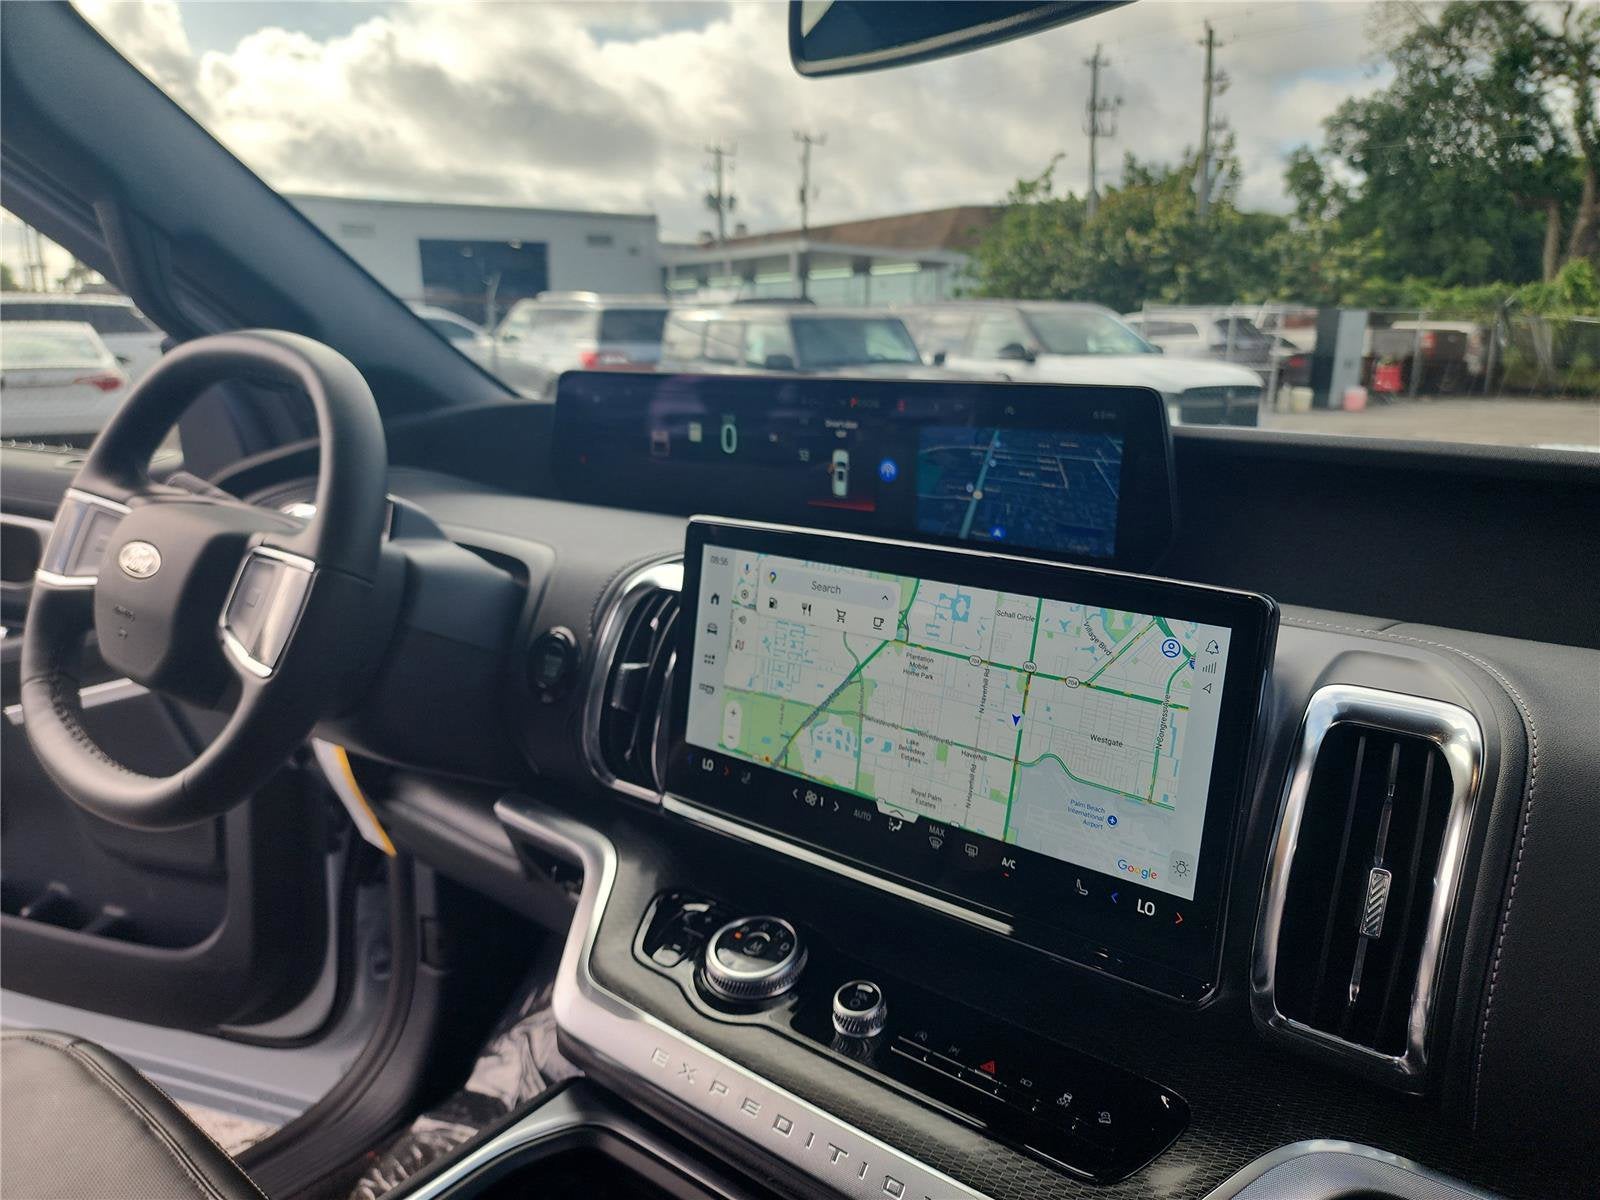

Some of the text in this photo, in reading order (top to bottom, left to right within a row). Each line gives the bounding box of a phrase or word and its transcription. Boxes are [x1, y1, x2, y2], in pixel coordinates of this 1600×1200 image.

[721, 423, 737, 453] 0
[811, 580, 842, 596] Search
[995, 609, 1036, 623] Schall Circle
[1083, 620, 1112, 656] Village Blvd
[906, 652, 934, 664] Plantation
[909, 661, 928, 671] Mobile
[983, 668, 990, 678] Rd
[903, 668, 934, 681] Home Park
[1067, 679, 1078, 687] 704
[1157, 708, 1168, 742] Congress
[905, 738, 919, 747] Lake
[1090, 733, 1124, 748] Westgate
[911, 787, 943, 802] Royal Palm
[915, 798, 936, 809] Estates
[1070, 799, 1105, 813] Palm Beach
[853, 808, 872, 822] AUTO
[1067, 806, 1105, 822] International
[928, 824, 945, 838] MAX
[1082, 819, 1103, 830] Airport
[1001, 856, 1016, 870] A/C
[1117, 859, 1158, 880] Google
[1137, 898, 1156, 917] LO
[651, 1047, 932, 1200] EXPEDITIO
